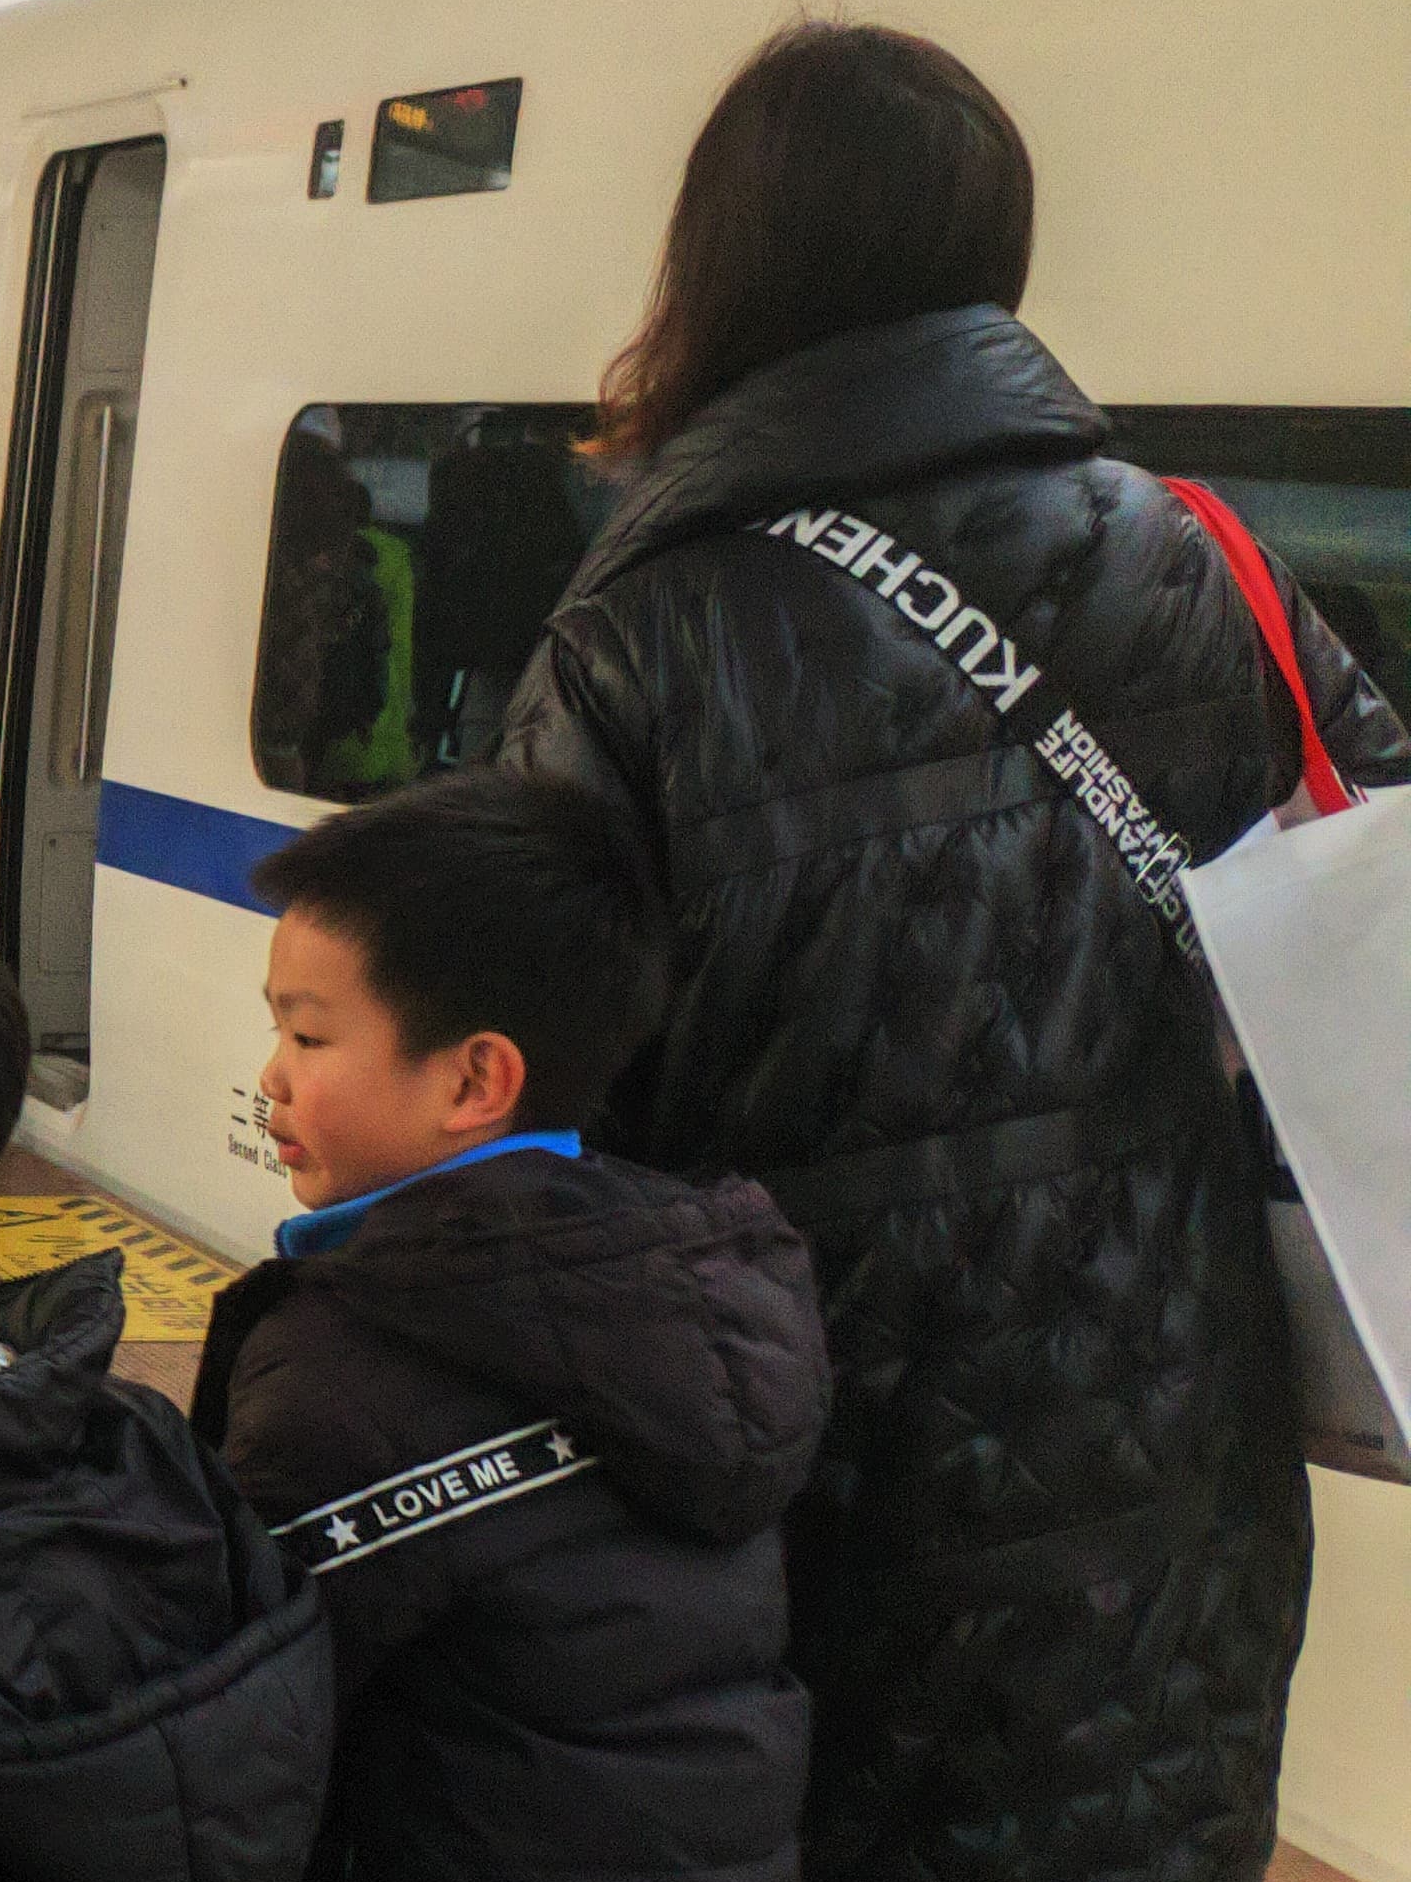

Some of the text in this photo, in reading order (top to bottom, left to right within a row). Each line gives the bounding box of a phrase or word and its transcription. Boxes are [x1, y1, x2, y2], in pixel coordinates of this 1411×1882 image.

[766, 509, 1042, 714] KUCHEN
[227, 1132, 259, 1165] Second
[371, 1450, 522, 1528] LOVE ME
